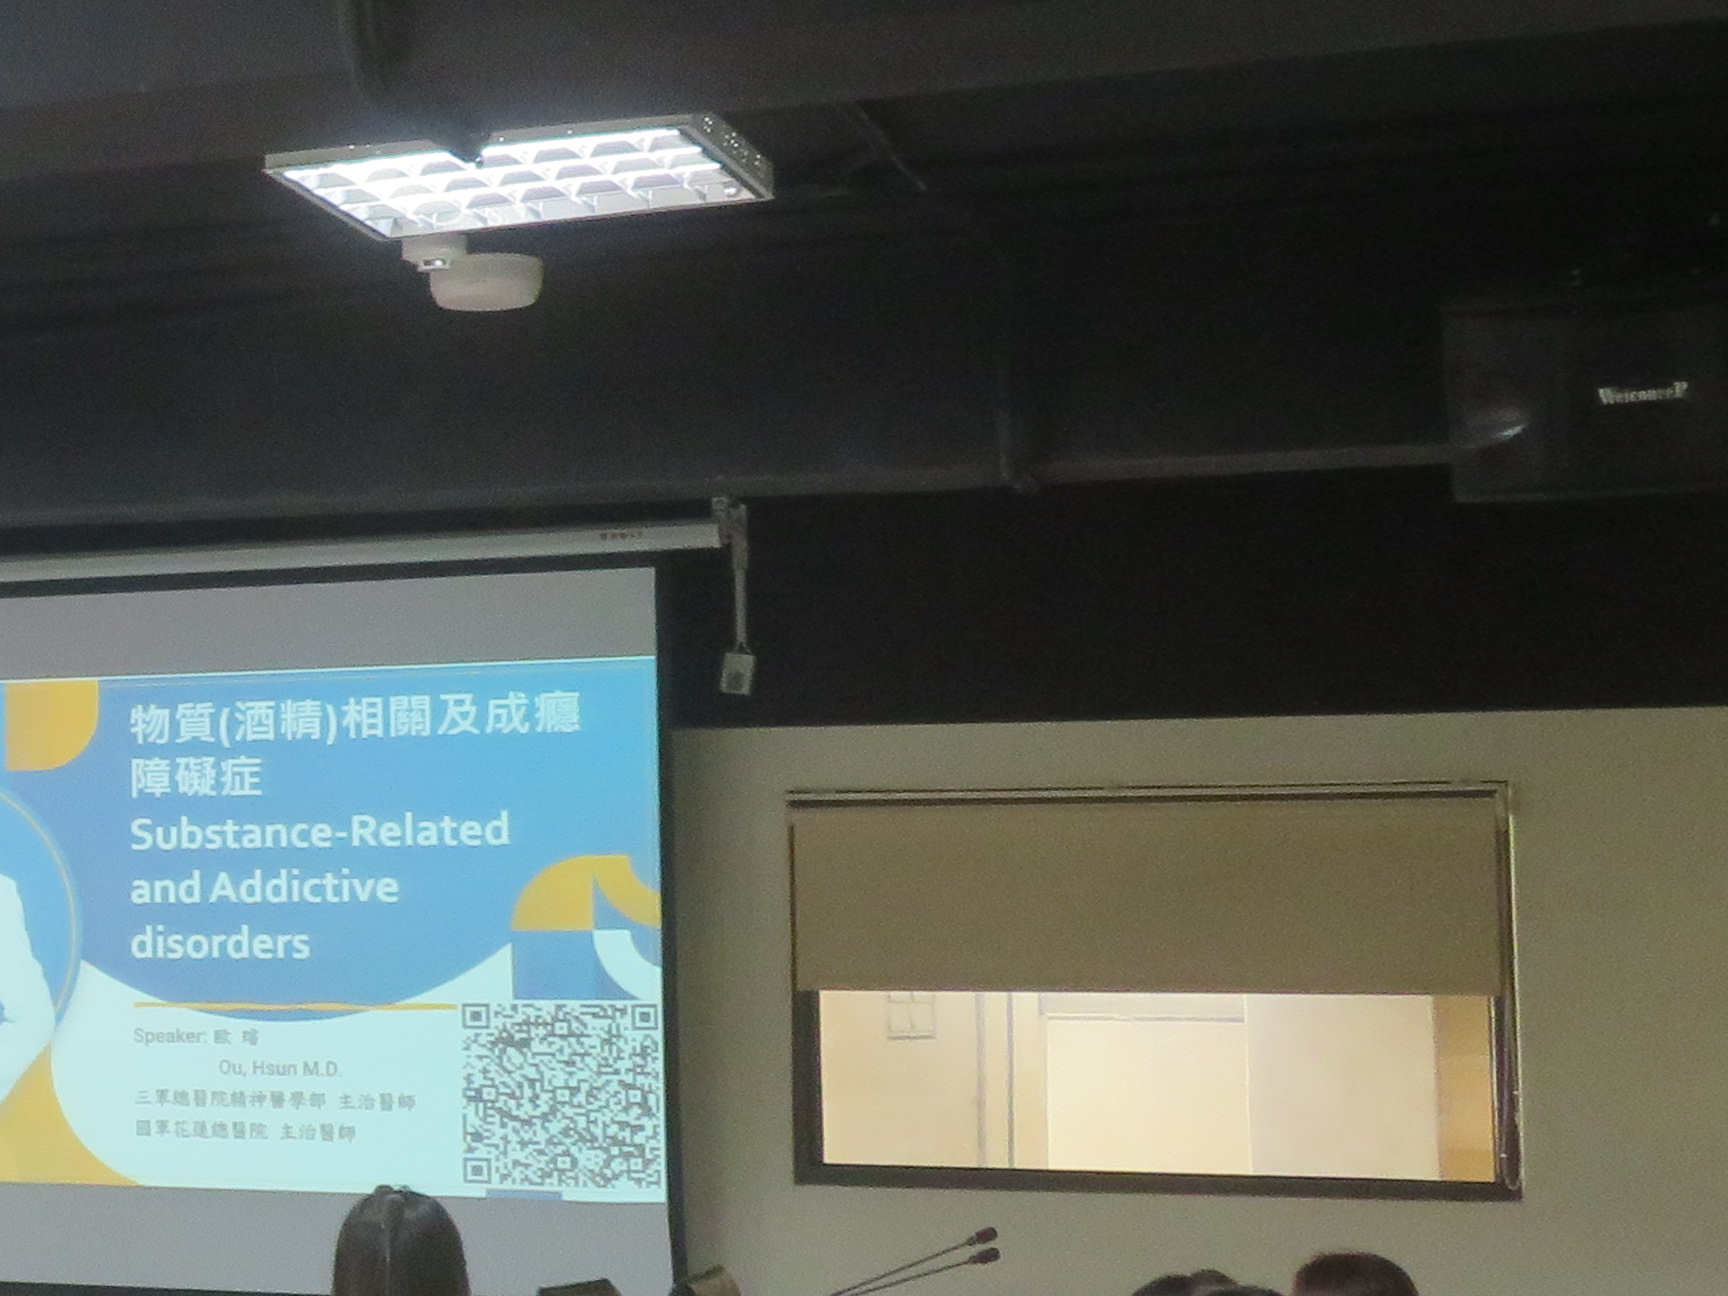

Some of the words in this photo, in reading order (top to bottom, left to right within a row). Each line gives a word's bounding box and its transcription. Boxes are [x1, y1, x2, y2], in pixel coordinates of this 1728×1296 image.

[129, 690, 583, 747] 物質(酒精)相關及成癮
[129, 755, 264, 798] 障礙症
[129, 809, 512, 851] Substance-Related
[129, 869, 202, 905] and
[208, 867, 401, 905] Addictive
[129, 925, 312, 960] disorders
[133, 1027, 207, 1047] Speaker:
[219, 1059, 247, 1077] Ou,
[252, 1060, 298, 1077] Hsun
[302, 1060, 343, 1078] M.D.
